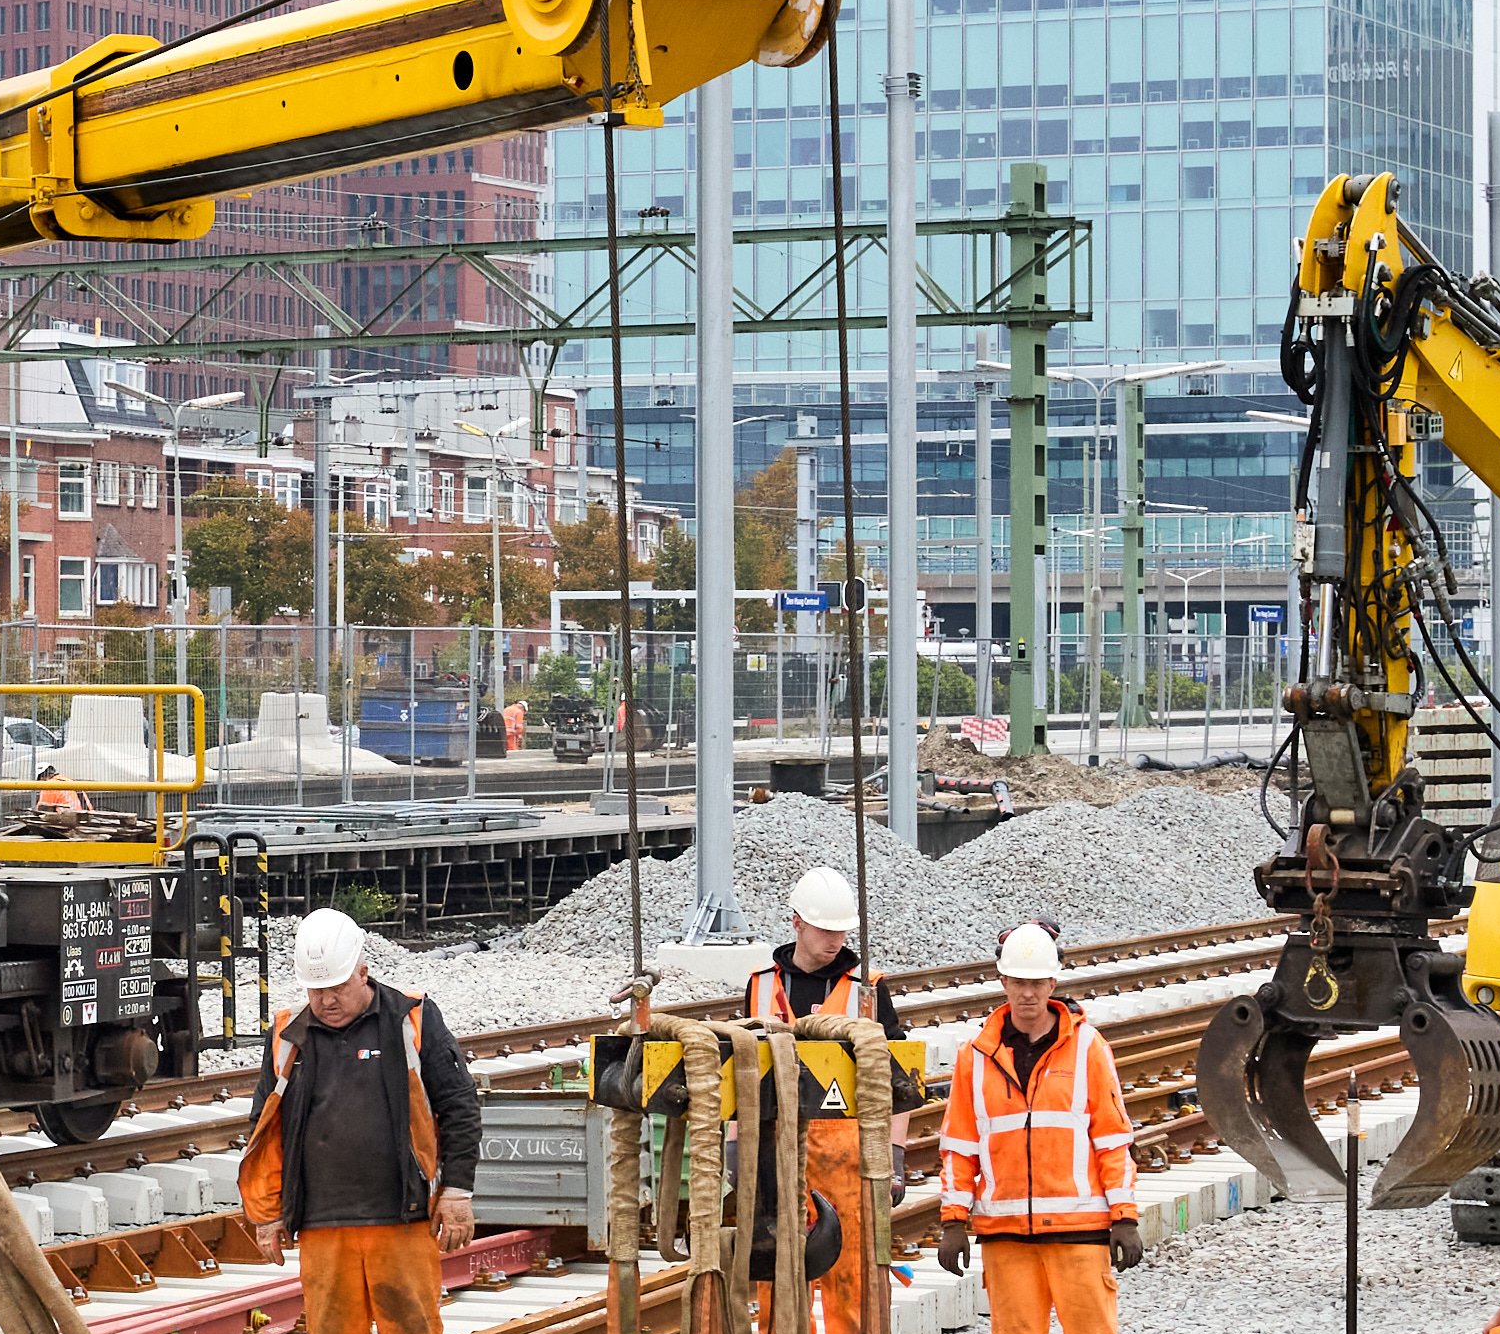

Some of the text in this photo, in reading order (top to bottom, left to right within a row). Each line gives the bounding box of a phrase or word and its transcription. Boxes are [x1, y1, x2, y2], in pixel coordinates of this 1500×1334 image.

[63, 886, 75, 902] 84
[121, 883, 131, 898] 94
[160, 877, 179, 900] V
[63, 905, 74, 920] 84
[62, 920, 113, 939] 963 5 002-8
[64, 984, 75, 998] 100
[121, 981, 128, 995] R
[129, 980, 139, 993] 90
